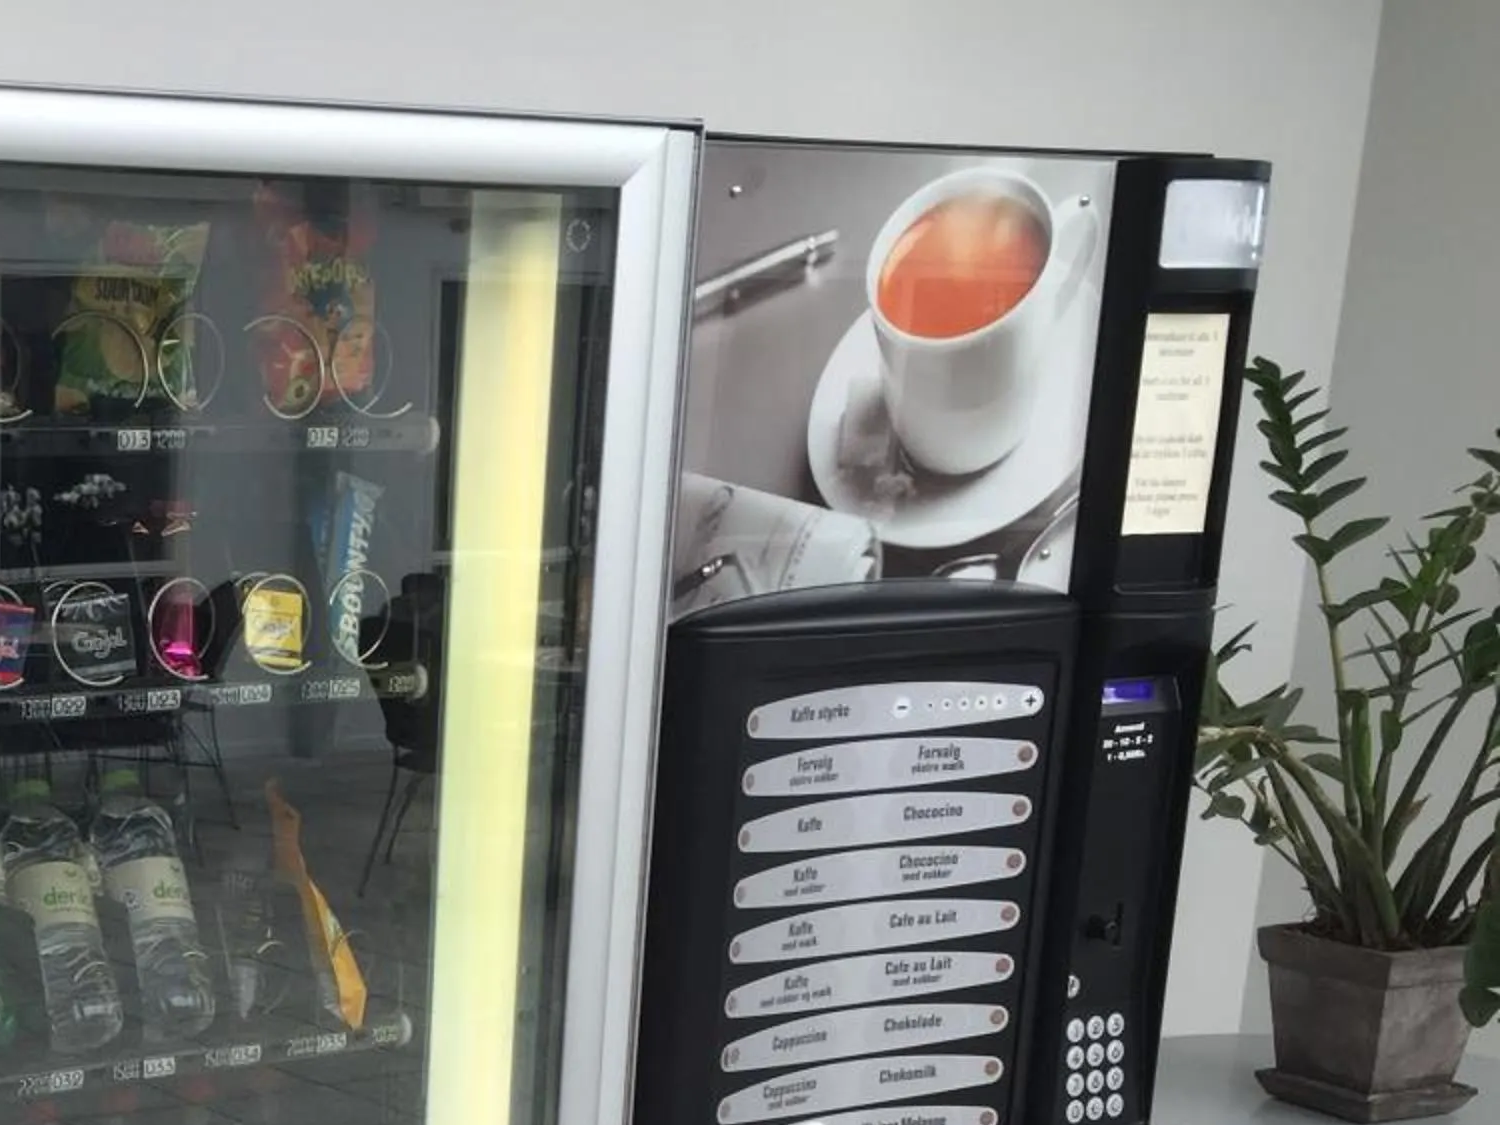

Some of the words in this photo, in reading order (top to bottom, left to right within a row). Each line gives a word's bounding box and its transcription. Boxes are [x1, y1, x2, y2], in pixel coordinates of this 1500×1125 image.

[904, 805, 963, 821] Chococino
[899, 854, 959, 869] Chococino
[883, 1015, 943, 1033] Chokolade
